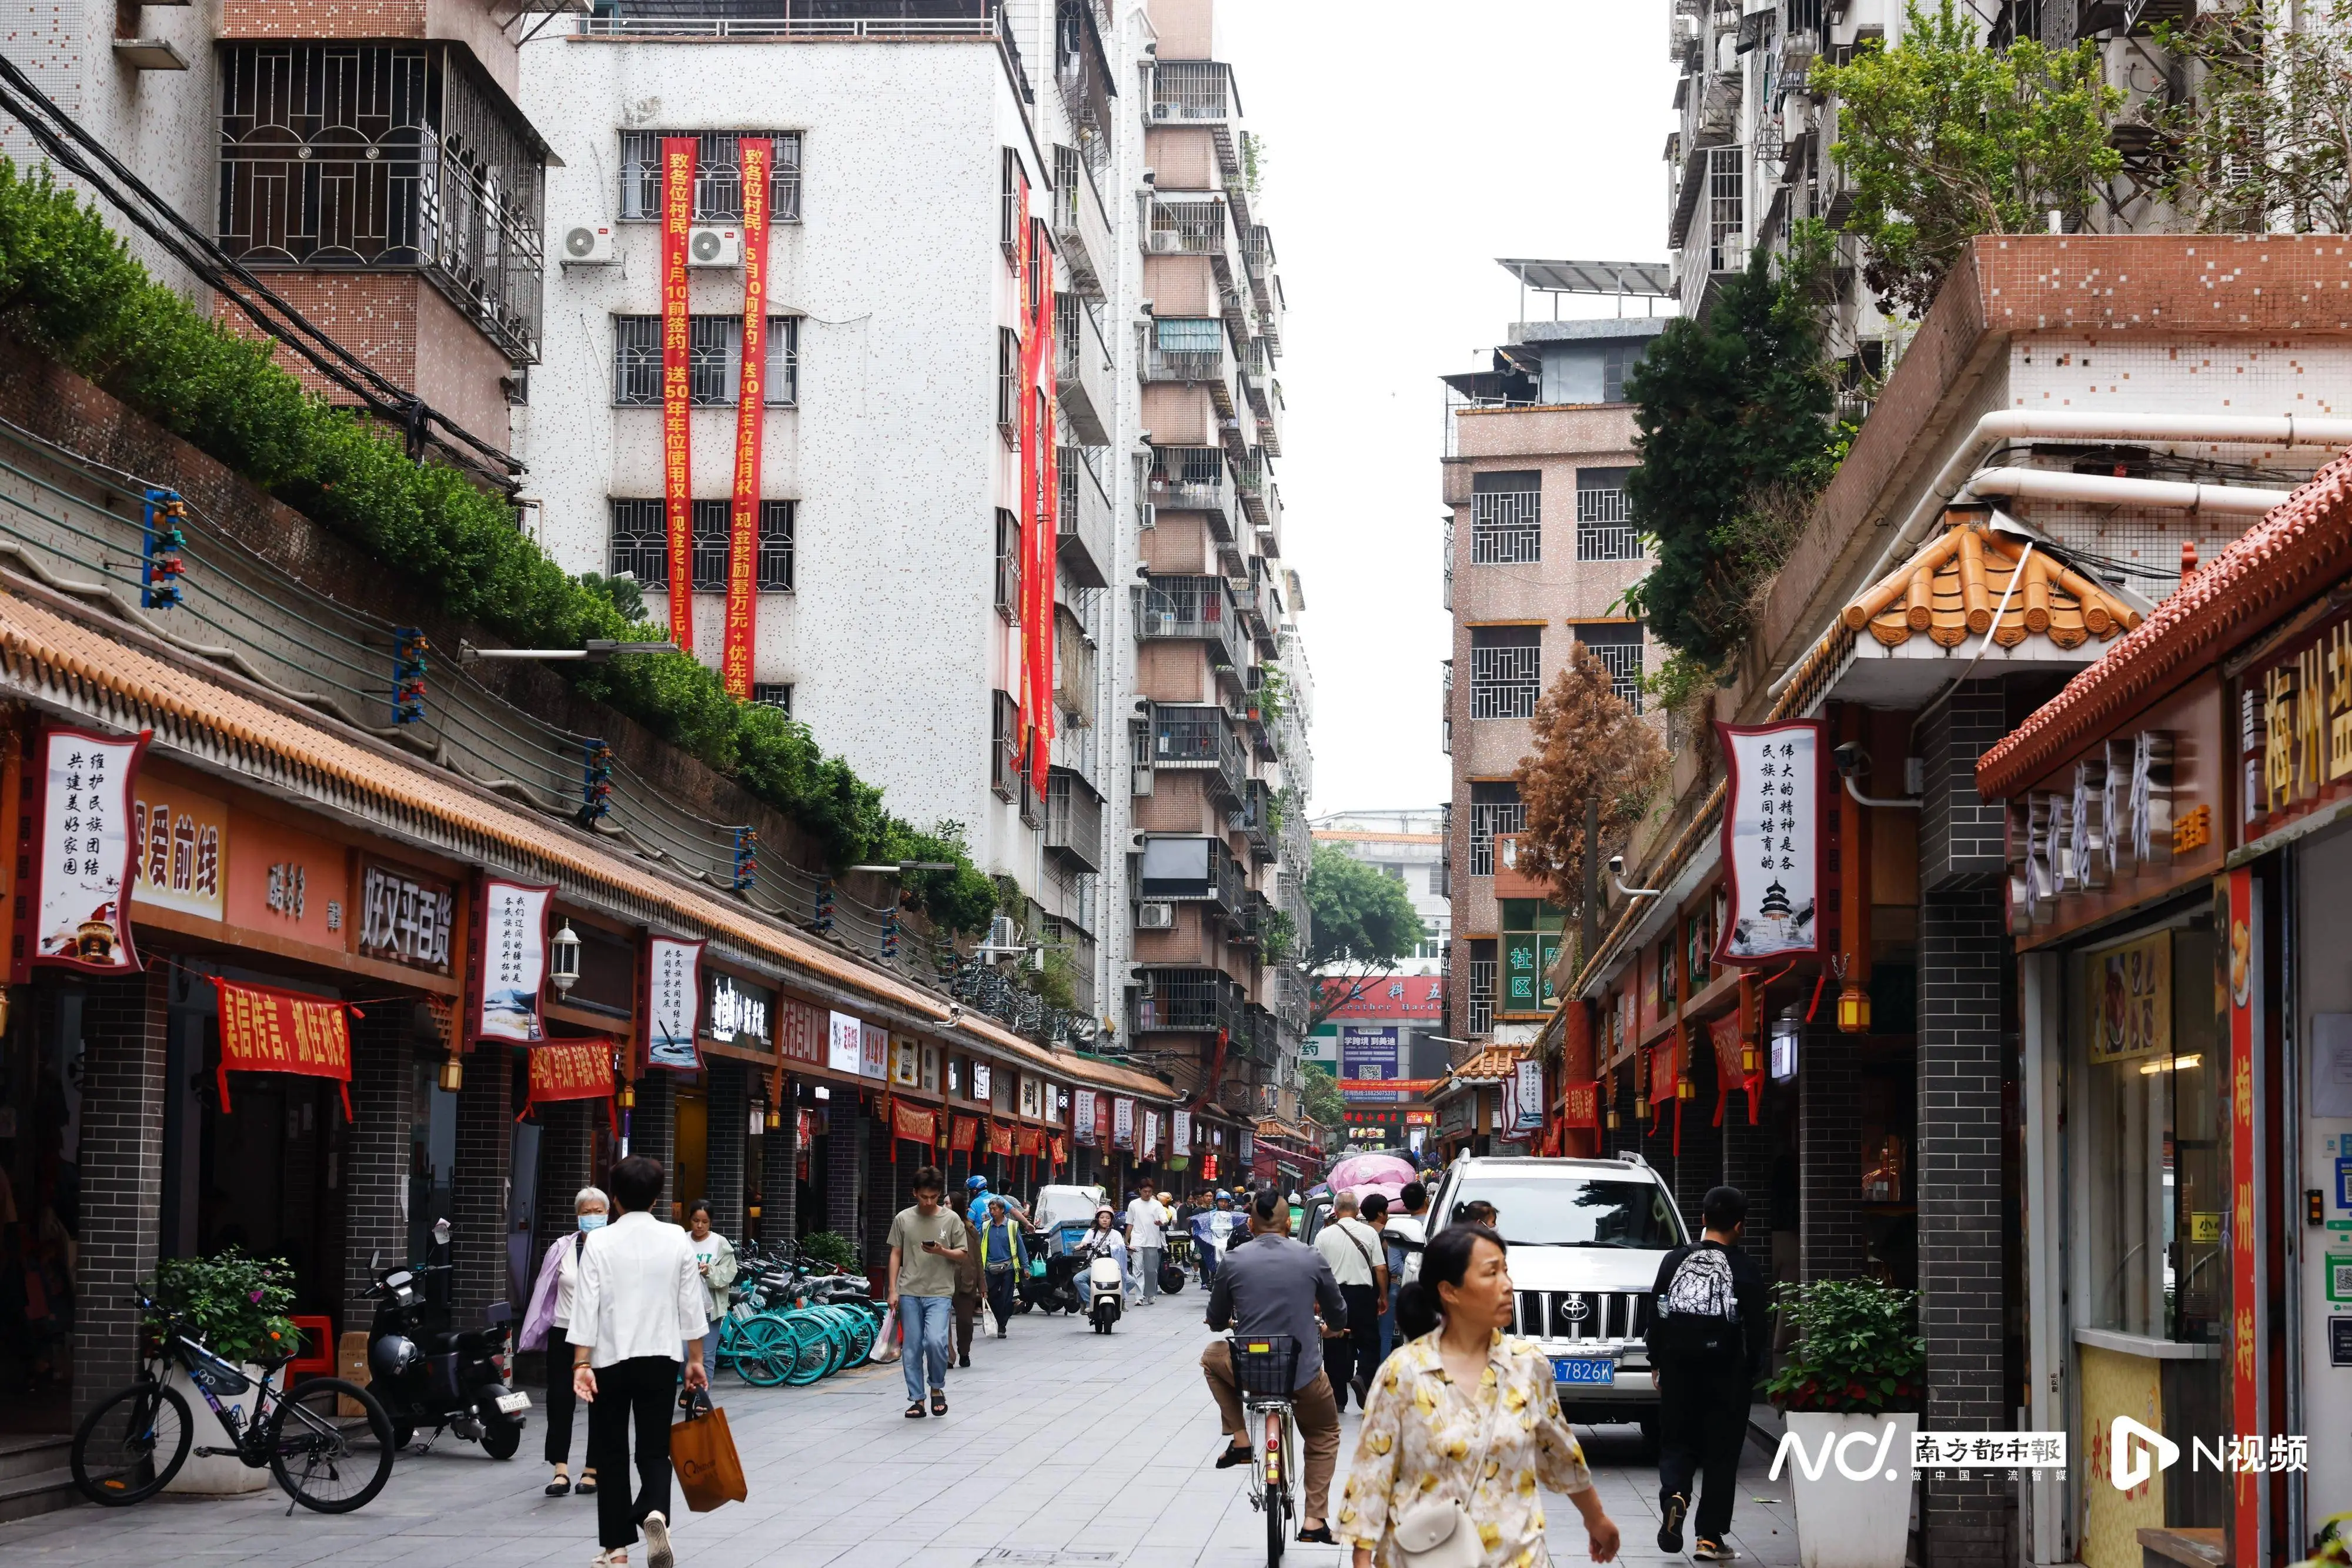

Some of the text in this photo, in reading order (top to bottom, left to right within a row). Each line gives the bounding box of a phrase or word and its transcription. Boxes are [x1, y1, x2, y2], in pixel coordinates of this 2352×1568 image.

[63, 751, 84, 875] 共建美好家园
[83, 752, 105, 877] 维护民族团结
[1760, 744, 1775, 870] 民族共同培育的
[1779, 744, 1795, 870] 伟大的精神是各
[360, 868, 452, 965] 好又平百货
[501, 897, 514, 982] 各民族共同开拓的
[512, 897, 525, 983] 我们辽阔的疆域是
[663, 950, 672, 1008] 共同繁荣发展
[673, 950, 683, 1038] 各民族共同团结奋斗
[1511, 948, 1532, 997] 社区
[1301, 1041, 1319, 1057] 药
[1344, 1037, 1395, 1046] 学跨境 到美迪
[2200, 1216, 2217, 1232] 小
